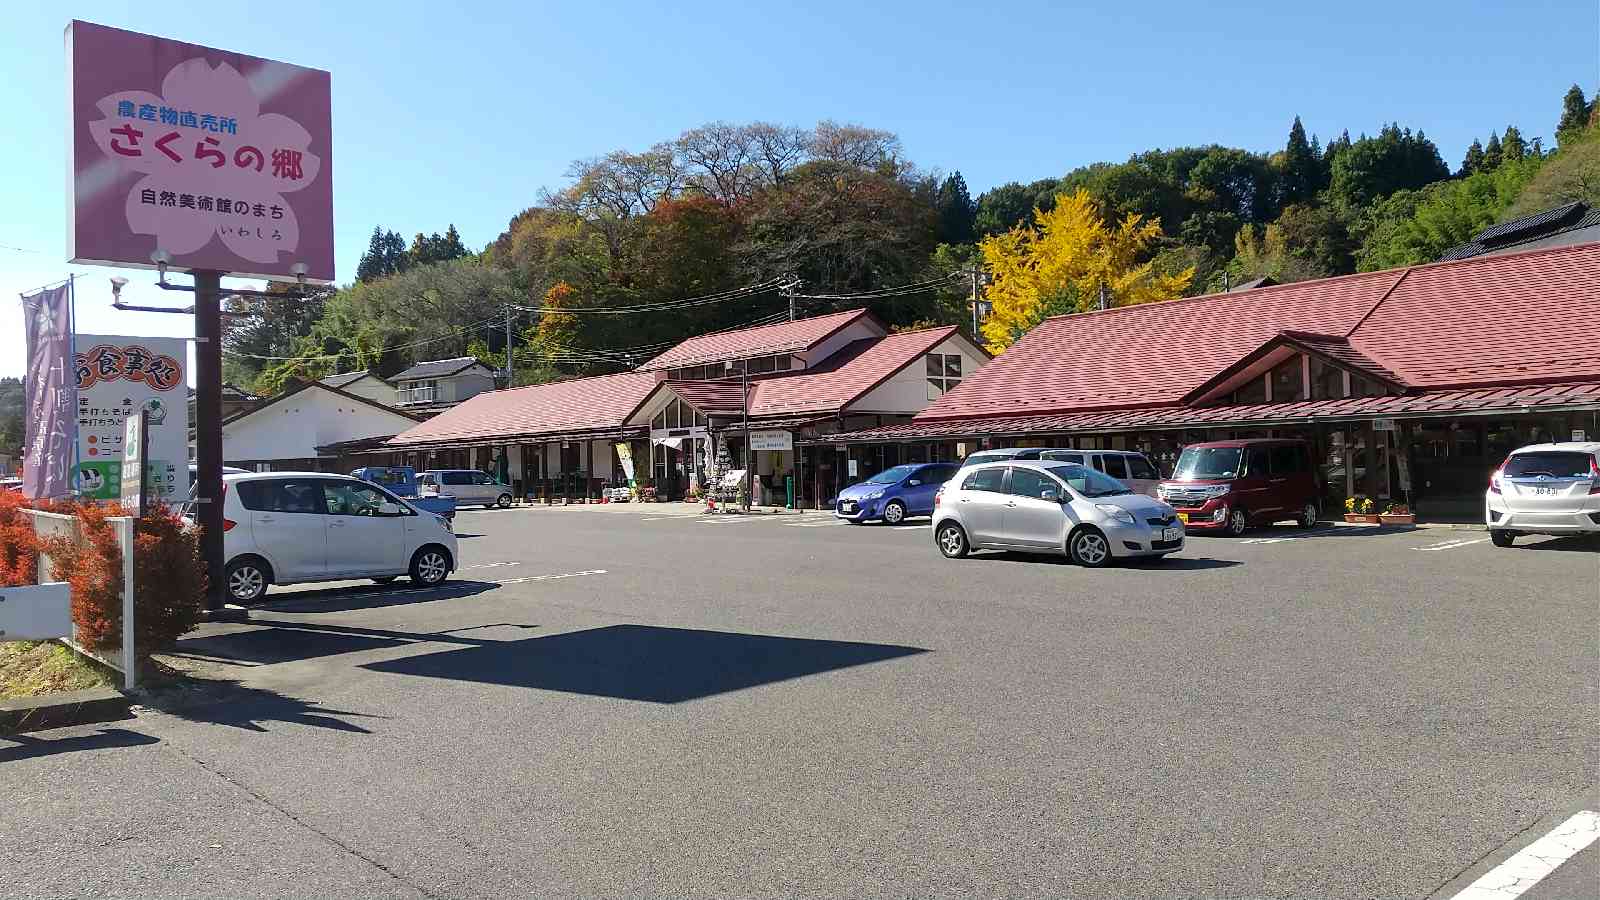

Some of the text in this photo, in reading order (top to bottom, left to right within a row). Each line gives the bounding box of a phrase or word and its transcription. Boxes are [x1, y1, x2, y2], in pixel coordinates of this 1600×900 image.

[117, 99, 238, 135] 農産物直売所
[109, 123, 304, 181] さくらの郷
[140, 188, 284, 220] 自然美術館のまち
